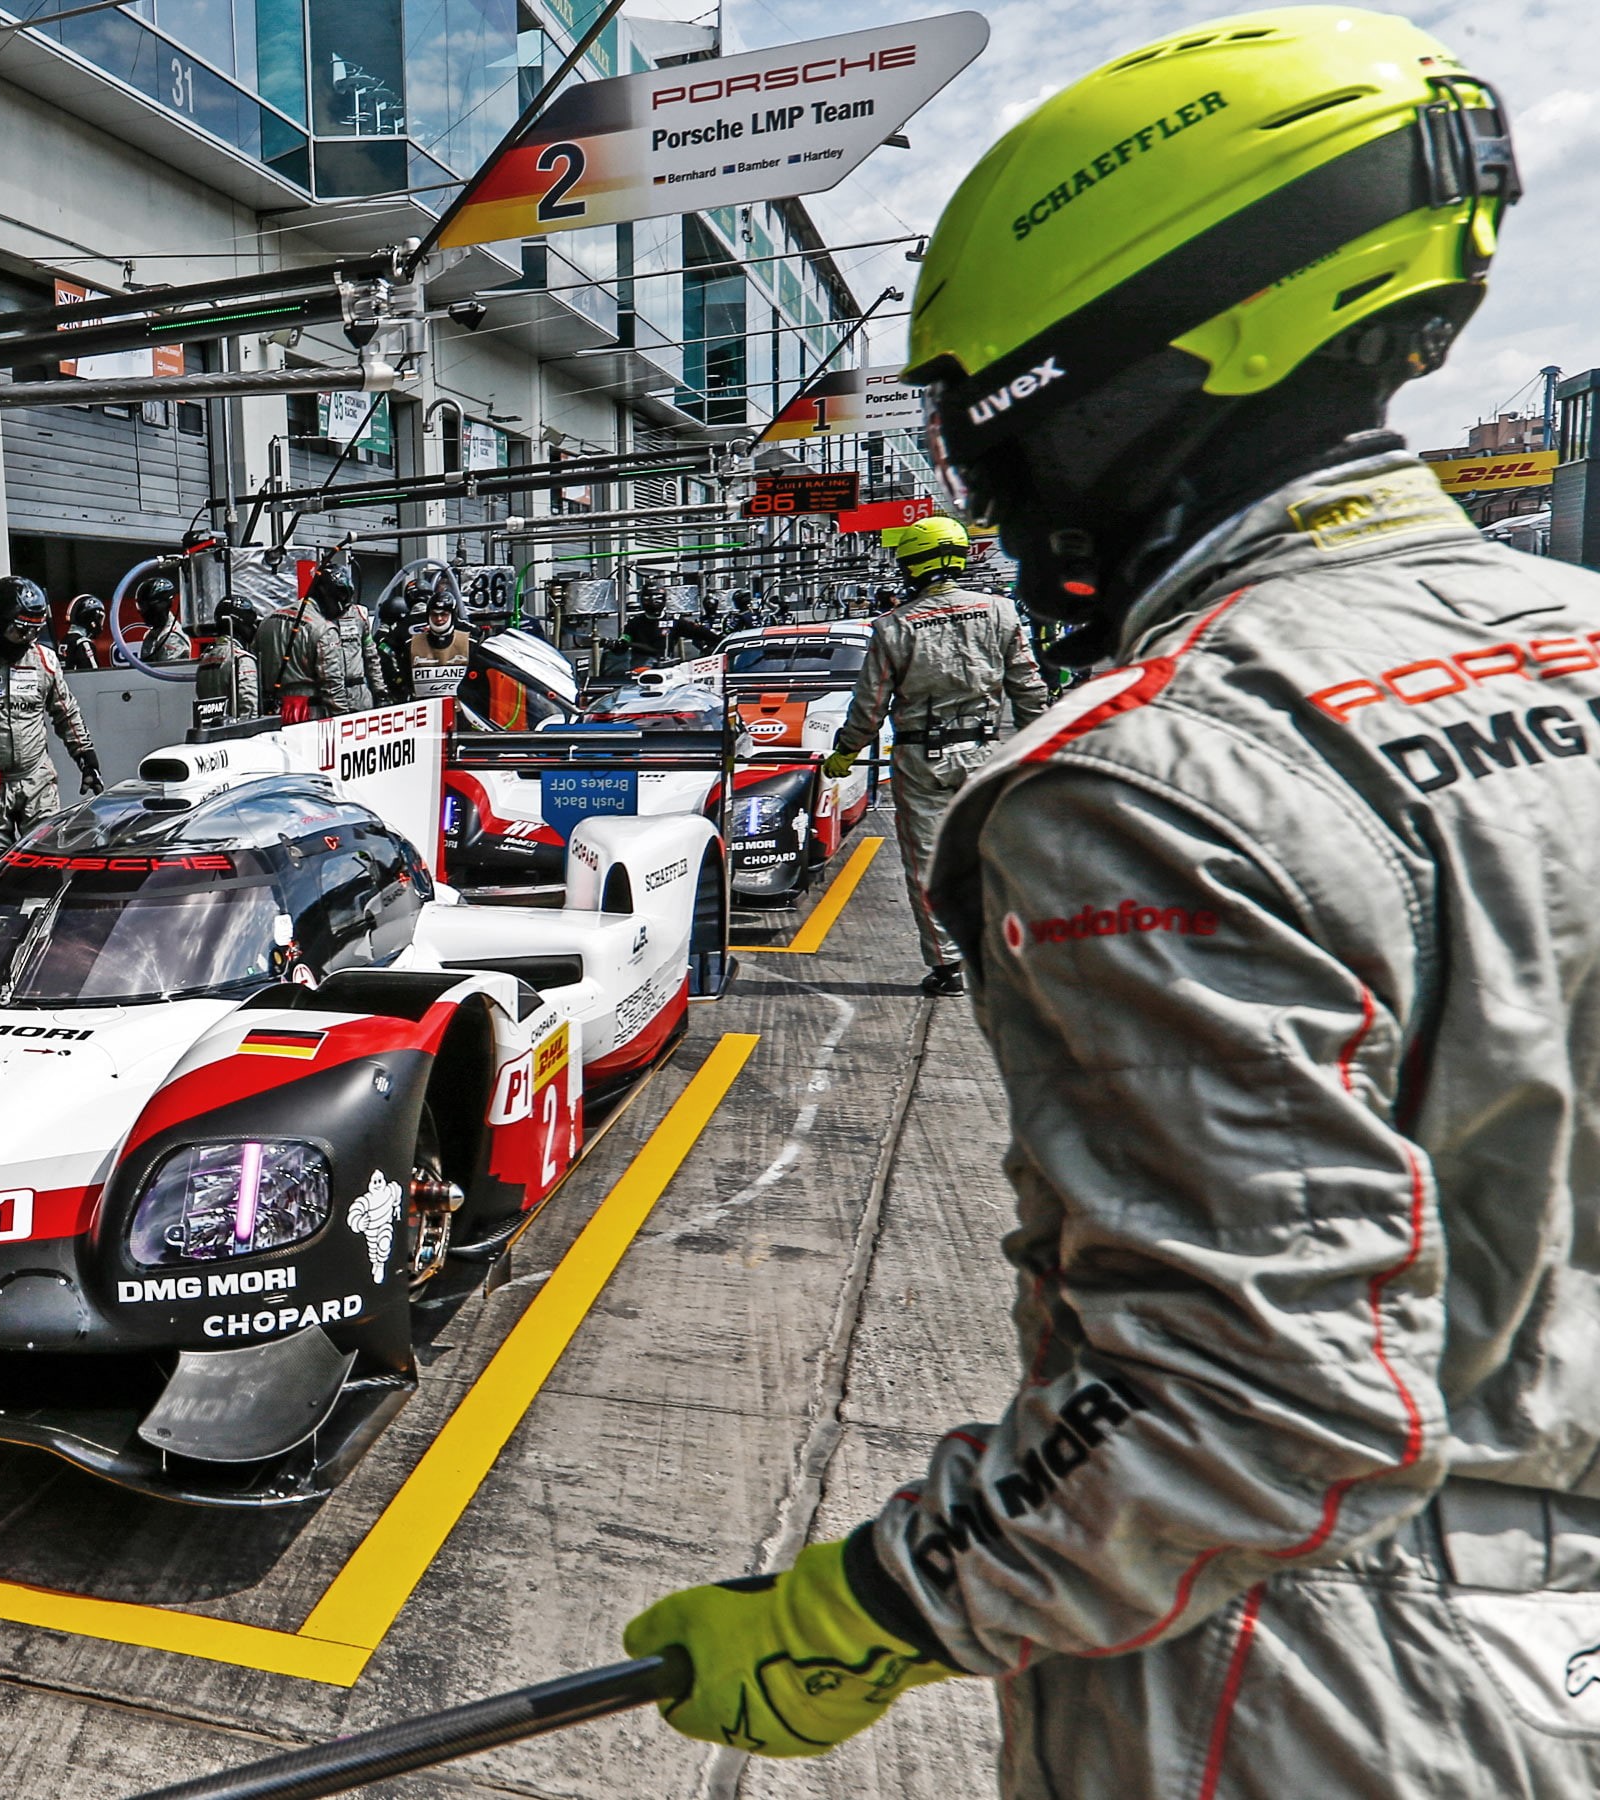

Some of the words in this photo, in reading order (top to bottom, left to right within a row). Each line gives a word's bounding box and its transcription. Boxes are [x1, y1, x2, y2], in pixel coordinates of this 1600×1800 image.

[171, 57, 194, 114] 31
[652, 45, 916, 110] PORSCHE
[652, 121, 744, 151] Porsche
[752, 106, 804, 136] LMP
[811, 98, 875, 125] Team
[536, 142, 586, 221] 2
[667, 166, 717, 185] Bernhard
[737, 156, 781, 174] Bamber
[803, 146, 844, 164] Hartley
[1011, 90, 1229, 241] SCHAEFFLER
[865, 391, 909, 404] Porsche
[968, 355, 1067, 426] uvex
[811, 398, 832, 432] 1
[805, 479, 850, 489] RACING
[1455, 461, 1539, 484] DHL
[751, 492, 796, 513] 86
[903, 502, 930, 524] 95
[468, 573, 506, 609] 86
[725, 636, 867, 653] PORSCHE
[414, 669, 432, 679] PIT
[435, 668, 465, 678] LANE
[1307, 633, 1600, 725] PORS
[197, 702, 225, 715] CHOPAR
[341, 705, 427, 744] PORSCHE
[194, 753, 220, 775] Mobil
[341, 746, 376, 781] DMG
[380, 737, 416, 772] MORI
[1379, 705, 1588, 794] DMG
[549, 779, 576, 791] OFF
[581, 779, 629, 791] Brakes
[553, 796, 587, 809] Back
[592, 797, 625, 809] Push
[503, 820, 543, 837] HY
[745, 840, 776, 851] MORI
[3, 851, 233, 871] PORSCHE
[571, 837, 599, 871] CHOPARD
[743, 852, 797, 866] CHOPARD
[645, 858, 688, 892] SCHAEFFLER
[1030, 901, 1220, 945] vodafone
[531, 1011, 557, 1044] CHOPARD
[539, 1036, 564, 1072] DHL
[504, 1066, 532, 1116] P1
[540, 1083, 558, 1188] 2
[117, 1277, 202, 1303] DMG
[207, 1266, 297, 1298] MORI
[203, 1294, 363, 1338] CHOPARD
